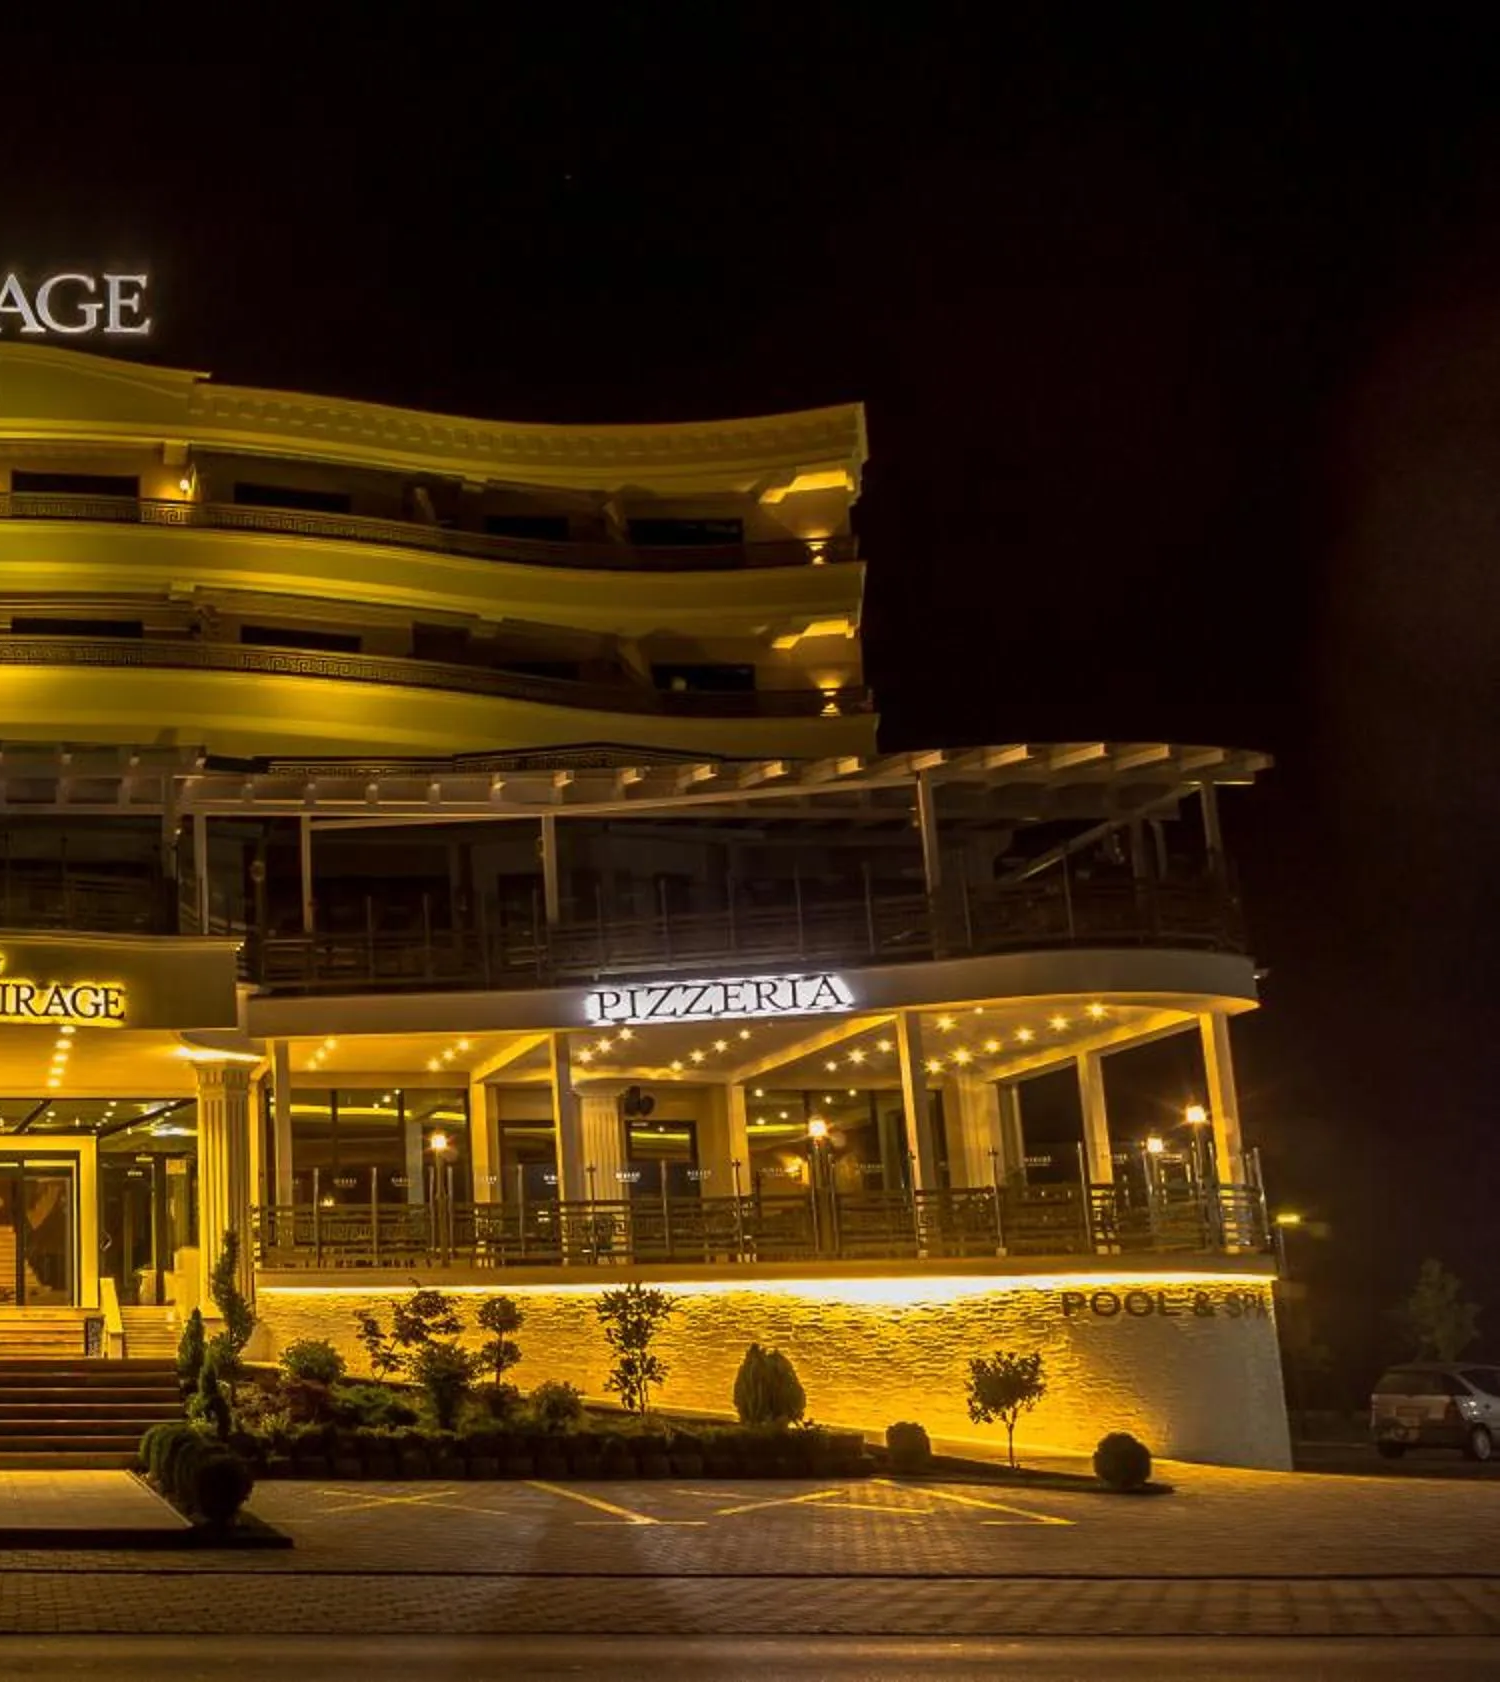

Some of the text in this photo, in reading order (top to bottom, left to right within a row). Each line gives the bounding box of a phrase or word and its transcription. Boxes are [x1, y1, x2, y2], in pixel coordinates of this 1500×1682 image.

[594, 973, 853, 1021] PIZZERIA
[1060, 1291, 1182, 1318] POOL
[1194, 1290, 1216, 1316] &
